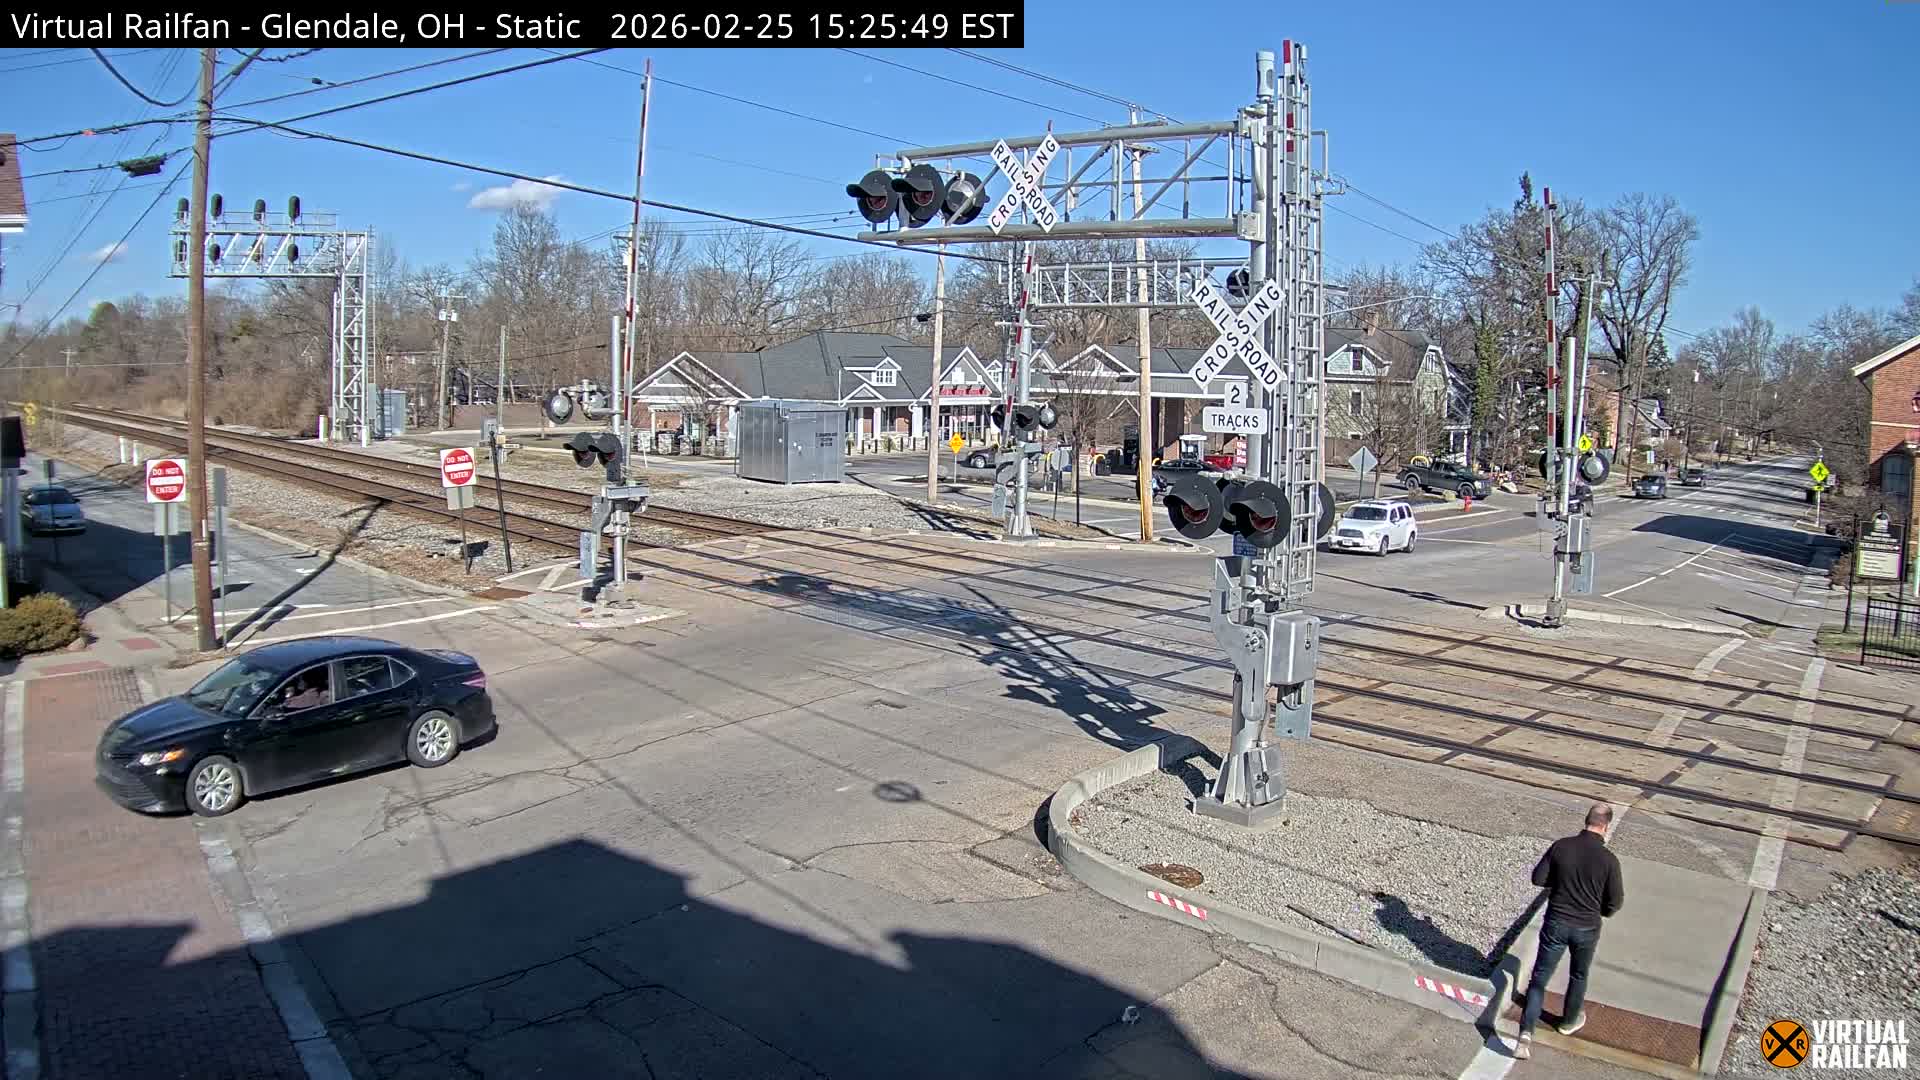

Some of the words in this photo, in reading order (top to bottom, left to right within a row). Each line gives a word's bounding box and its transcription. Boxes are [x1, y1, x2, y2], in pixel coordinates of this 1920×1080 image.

[991, 140, 1056, 228] CROSSING
[1195, 286, 1280, 383] CROSSING
[1230, 385, 1241, 404] 2
[1211, 413, 1259, 428] TRACKS
[446, 456, 455, 464] DO
[457, 454, 469, 463] NOT
[152, 468, 162, 476] DO
[165, 467, 180, 475] NOT
[450, 471, 469, 480] ENTER
[155, 486, 178, 494] ENTER
